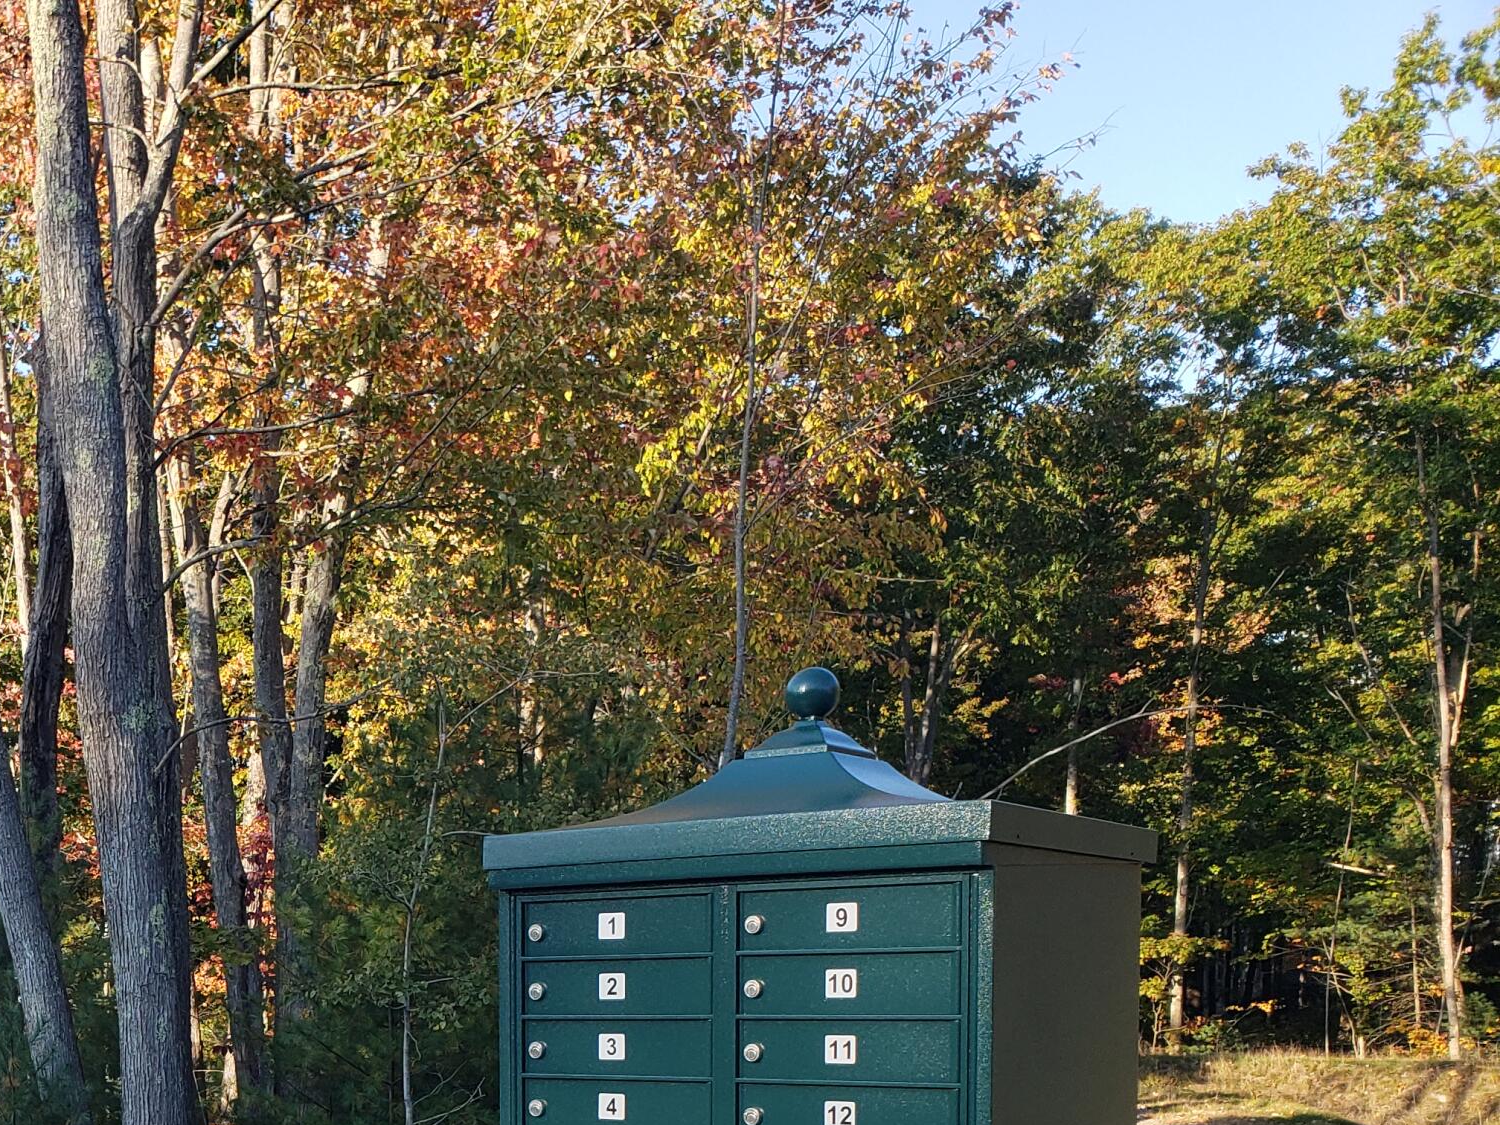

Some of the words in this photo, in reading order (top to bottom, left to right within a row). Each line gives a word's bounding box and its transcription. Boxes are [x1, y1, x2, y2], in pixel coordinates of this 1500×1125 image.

[608, 917, 616, 935] 1
[835, 907, 848, 928] 9
[606, 977, 618, 996] 2
[828, 973, 853, 993] 10
[606, 1037, 617, 1056] 3
[829, 1040, 852, 1060] 11
[606, 1097, 617, 1116] 4
[827, 1105, 852, 1125] 12
